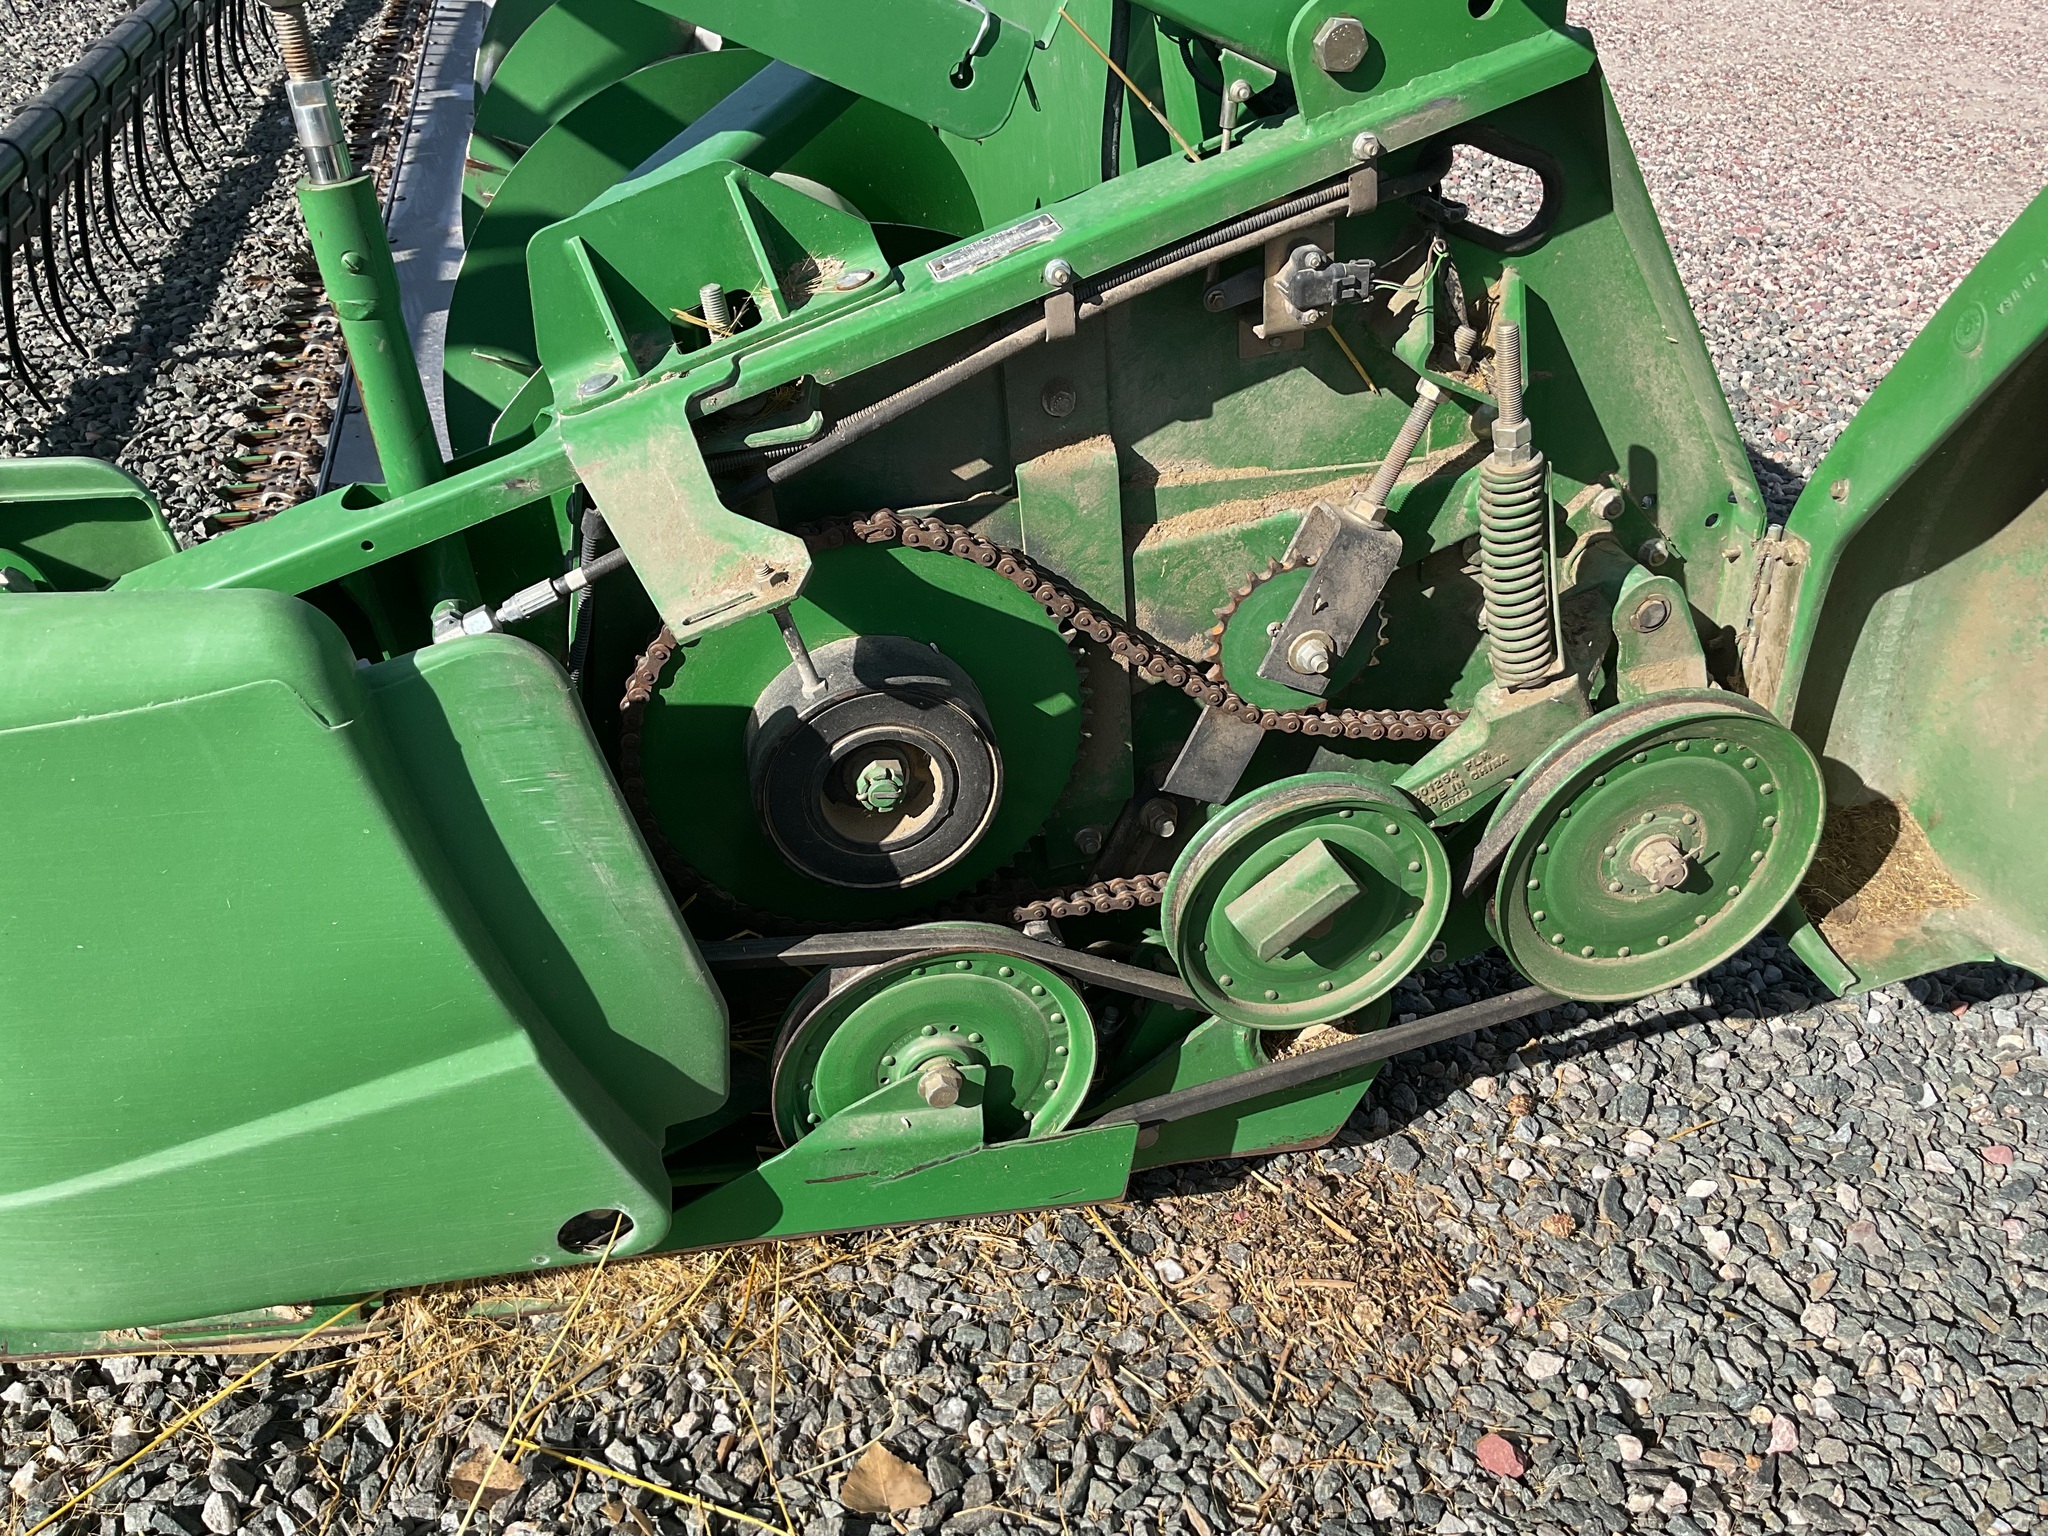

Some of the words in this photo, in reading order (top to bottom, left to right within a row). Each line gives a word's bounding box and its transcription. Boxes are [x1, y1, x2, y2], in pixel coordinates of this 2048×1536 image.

[1996, 290, 2020, 314] USA
[1420, 789, 1448, 807] ADE
[1451, 778, 1466, 792] IN
[1470, 753, 1510, 781] CHINA
